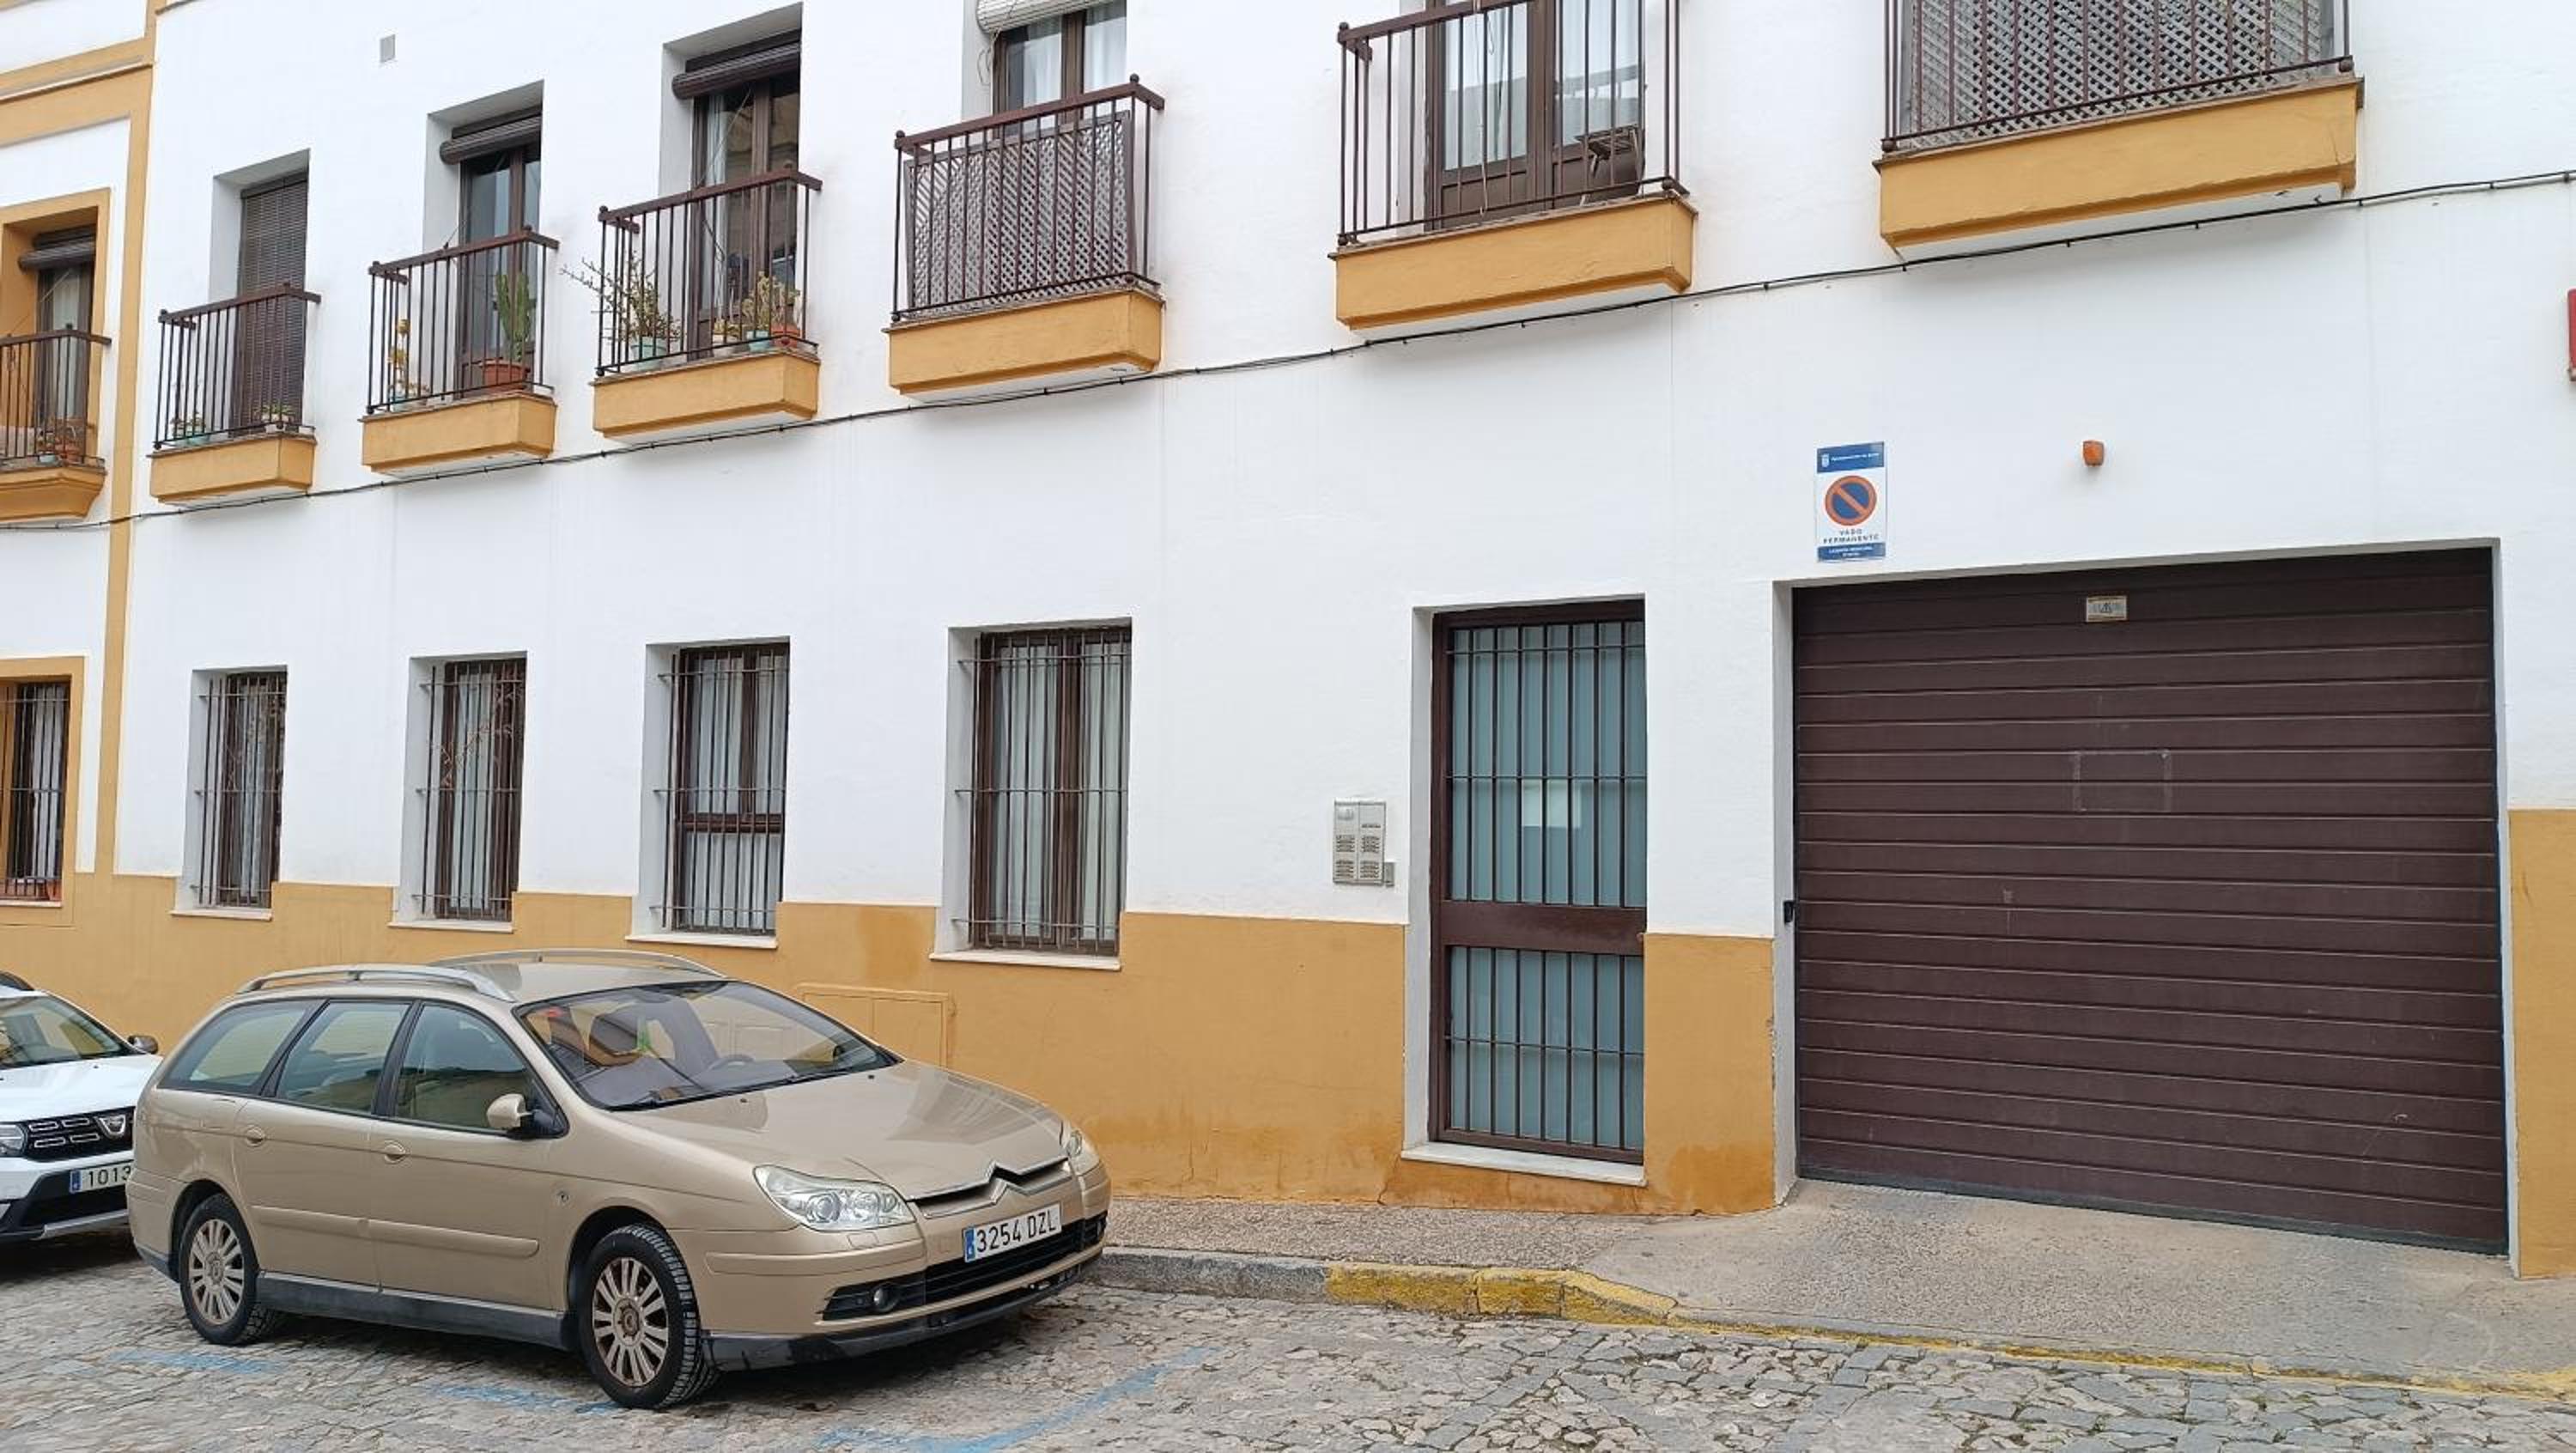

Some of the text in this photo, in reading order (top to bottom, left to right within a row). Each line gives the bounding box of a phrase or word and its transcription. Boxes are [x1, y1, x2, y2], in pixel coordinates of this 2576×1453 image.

[88, 1165, 131, 1188] 1013
[976, 1210, 1056, 1253] 3254 DZL
